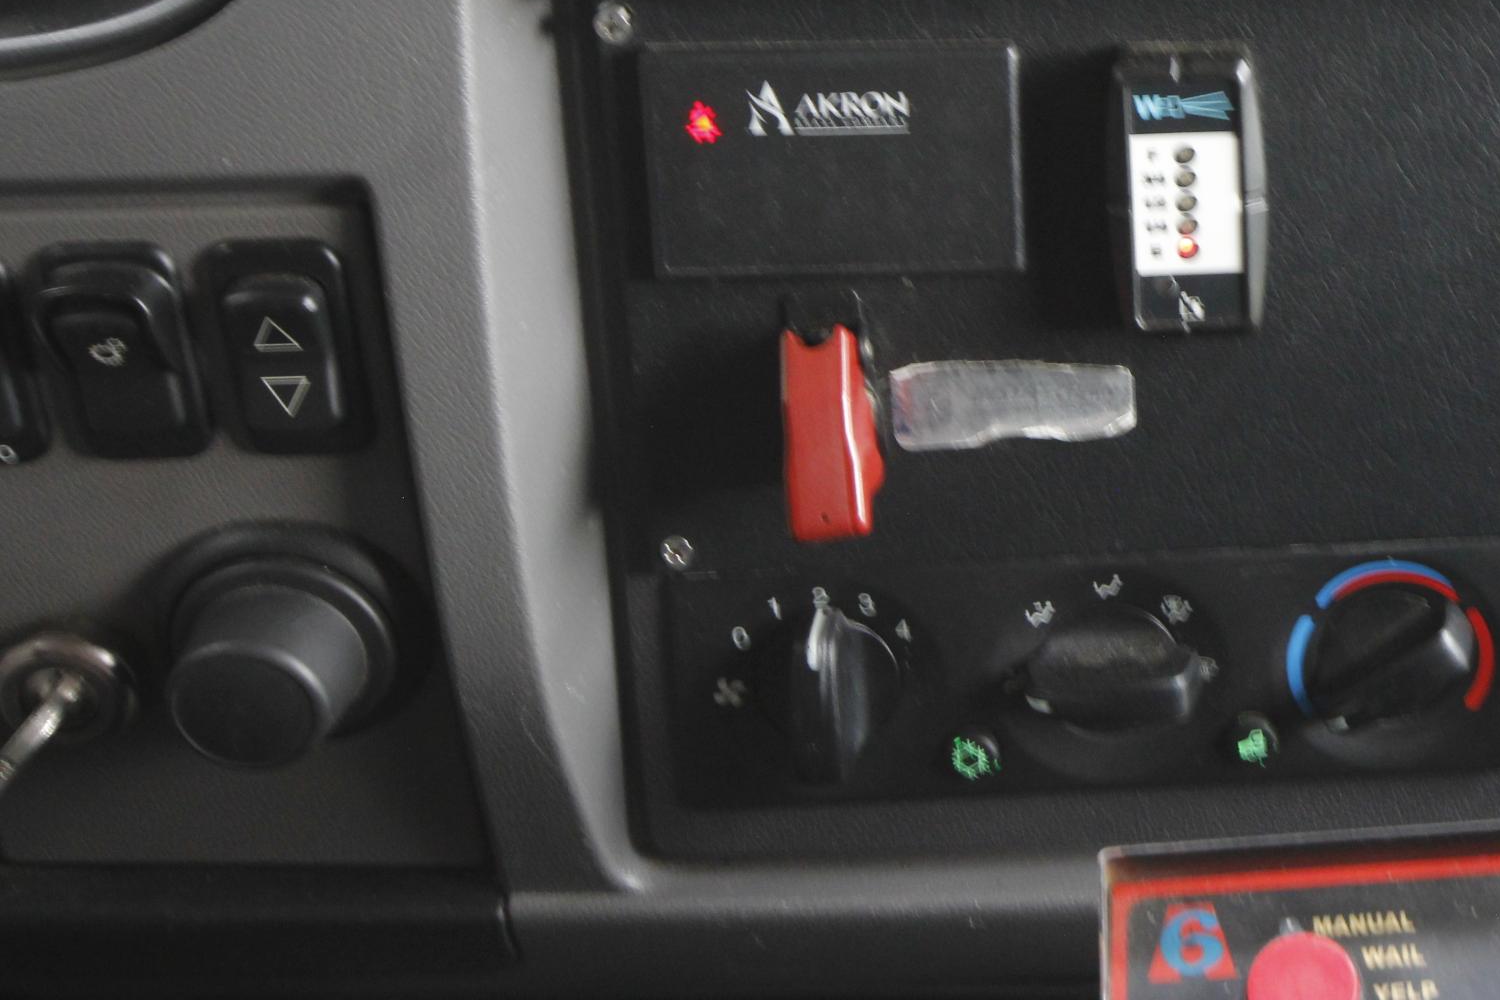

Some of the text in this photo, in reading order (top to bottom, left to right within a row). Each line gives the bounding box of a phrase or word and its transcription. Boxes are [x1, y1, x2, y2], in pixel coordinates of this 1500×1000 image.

[795, 91, 911, 122] AKRON
[1312, 910, 1416, 938] MANUAL
[1360, 943, 1428, 970] WAIL
[1372, 979, 1440, 1000] YELP
